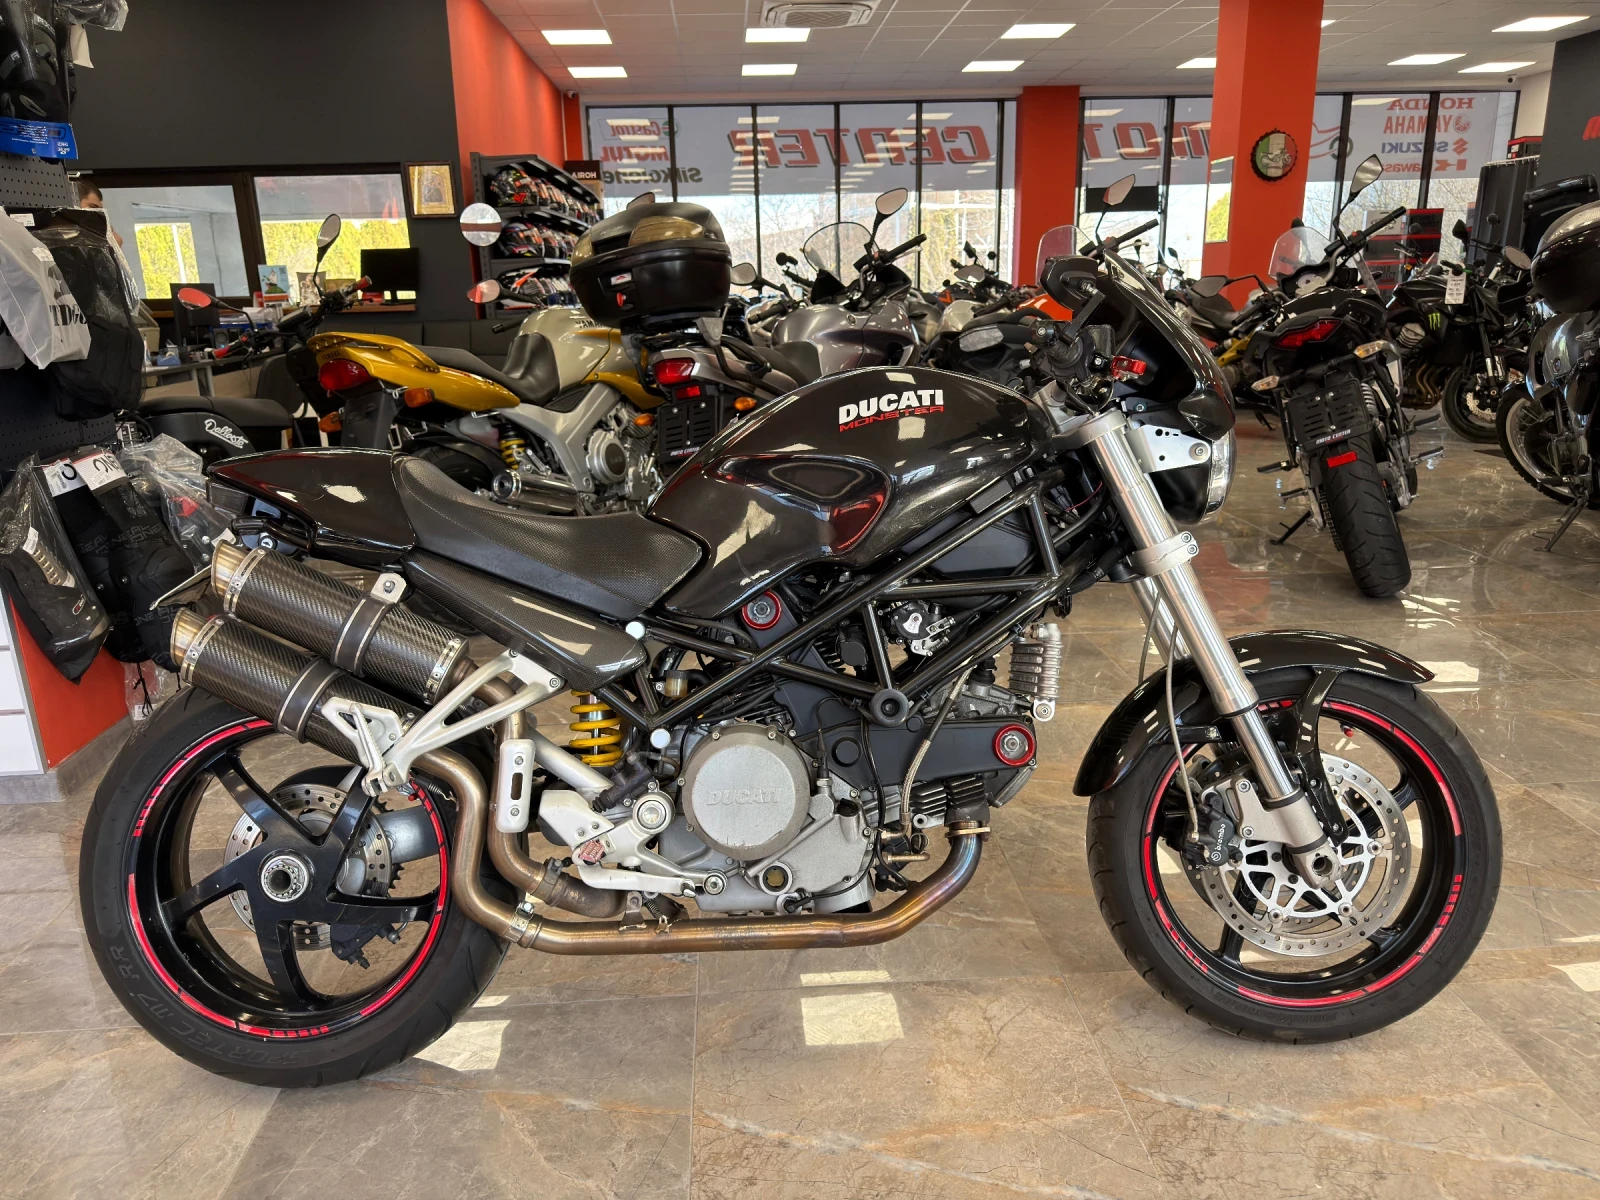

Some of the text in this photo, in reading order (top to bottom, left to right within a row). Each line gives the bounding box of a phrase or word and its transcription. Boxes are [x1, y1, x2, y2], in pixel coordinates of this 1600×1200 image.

[838, 389, 944, 425] DUCATI
[839, 405, 944, 433] MONSTER
[706, 788, 782, 806] DUCATI
[1214, 823, 1226, 851] brembo
